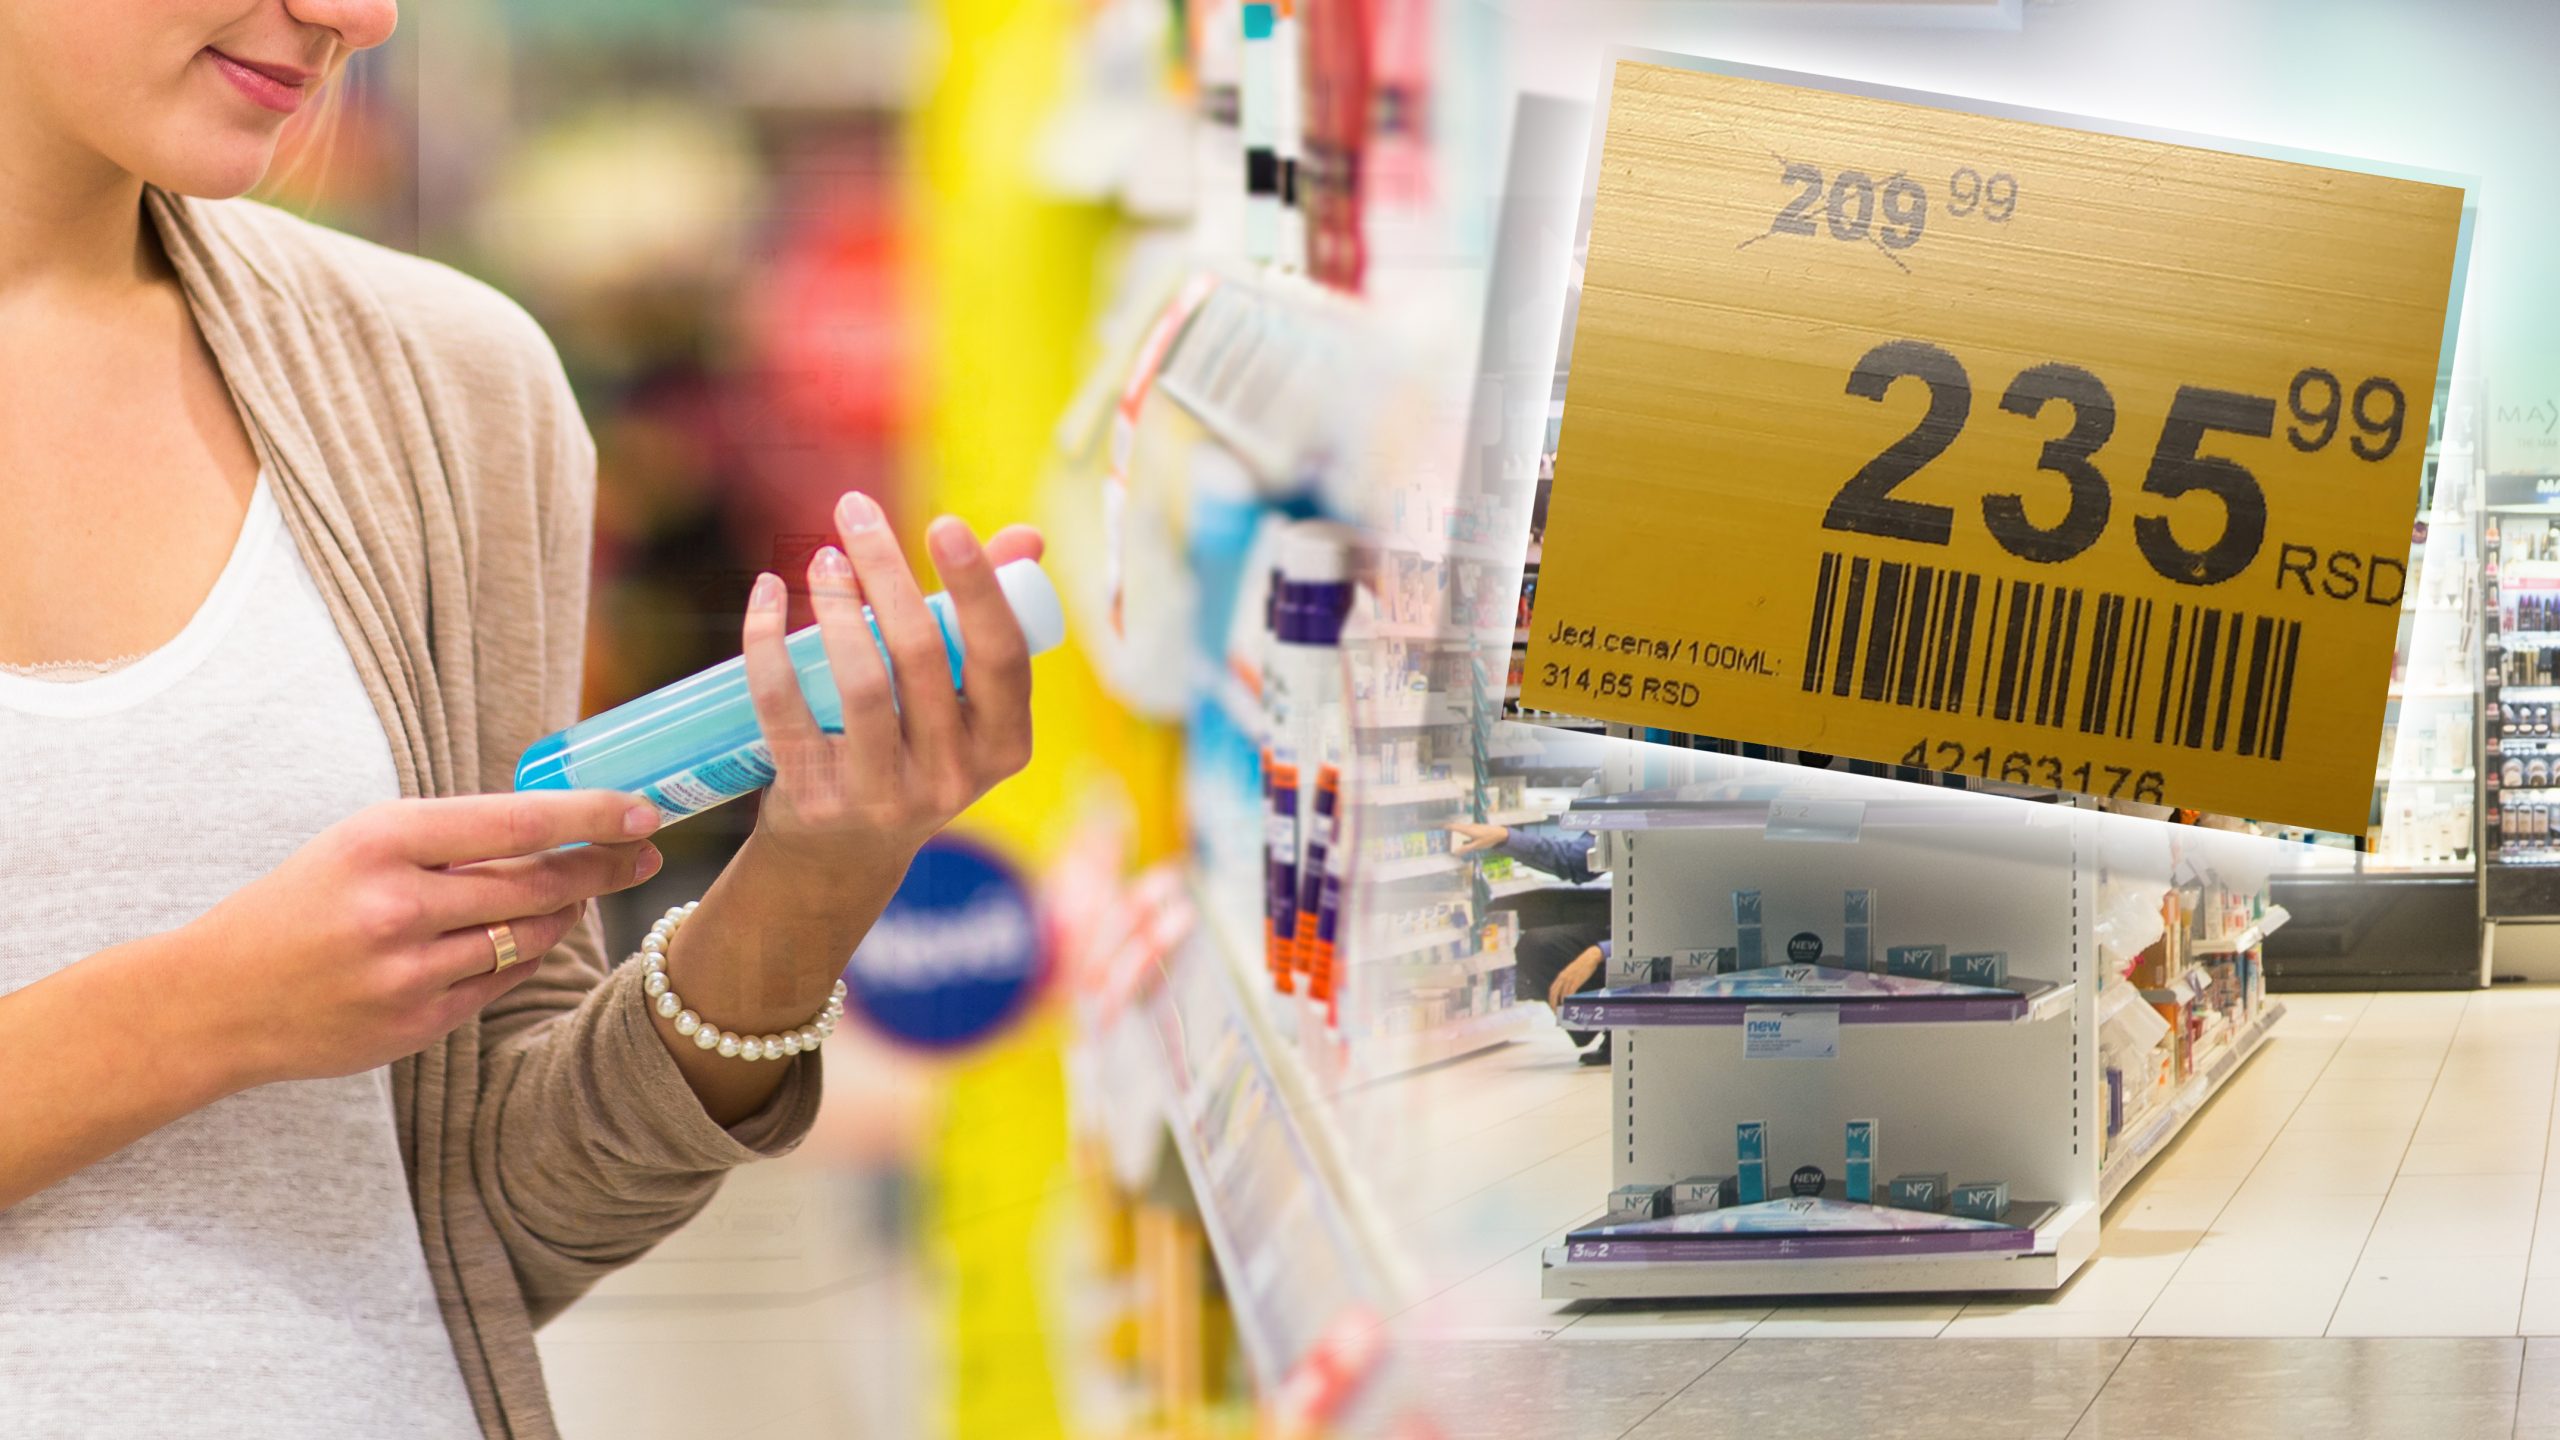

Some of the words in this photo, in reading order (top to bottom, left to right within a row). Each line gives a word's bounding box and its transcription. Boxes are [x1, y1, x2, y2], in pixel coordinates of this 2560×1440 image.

[1770, 162, 1928, 250] 209
[1946, 165, 2019, 224] 99
[1822, 338, 2277, 587] 235
[2286, 367, 2406, 462] 99
[2275, 542, 2407, 607] RSD
[1688, 641, 1782, 677] 100ML:
[1542, 662, 1633, 699] 314,65
[1640, 677, 1700, 708] RSD
[1791, 940, 1820, 950] NEW
[1748, 1020, 1782, 1032] new
[1793, 1173, 1823, 1184] NEW
